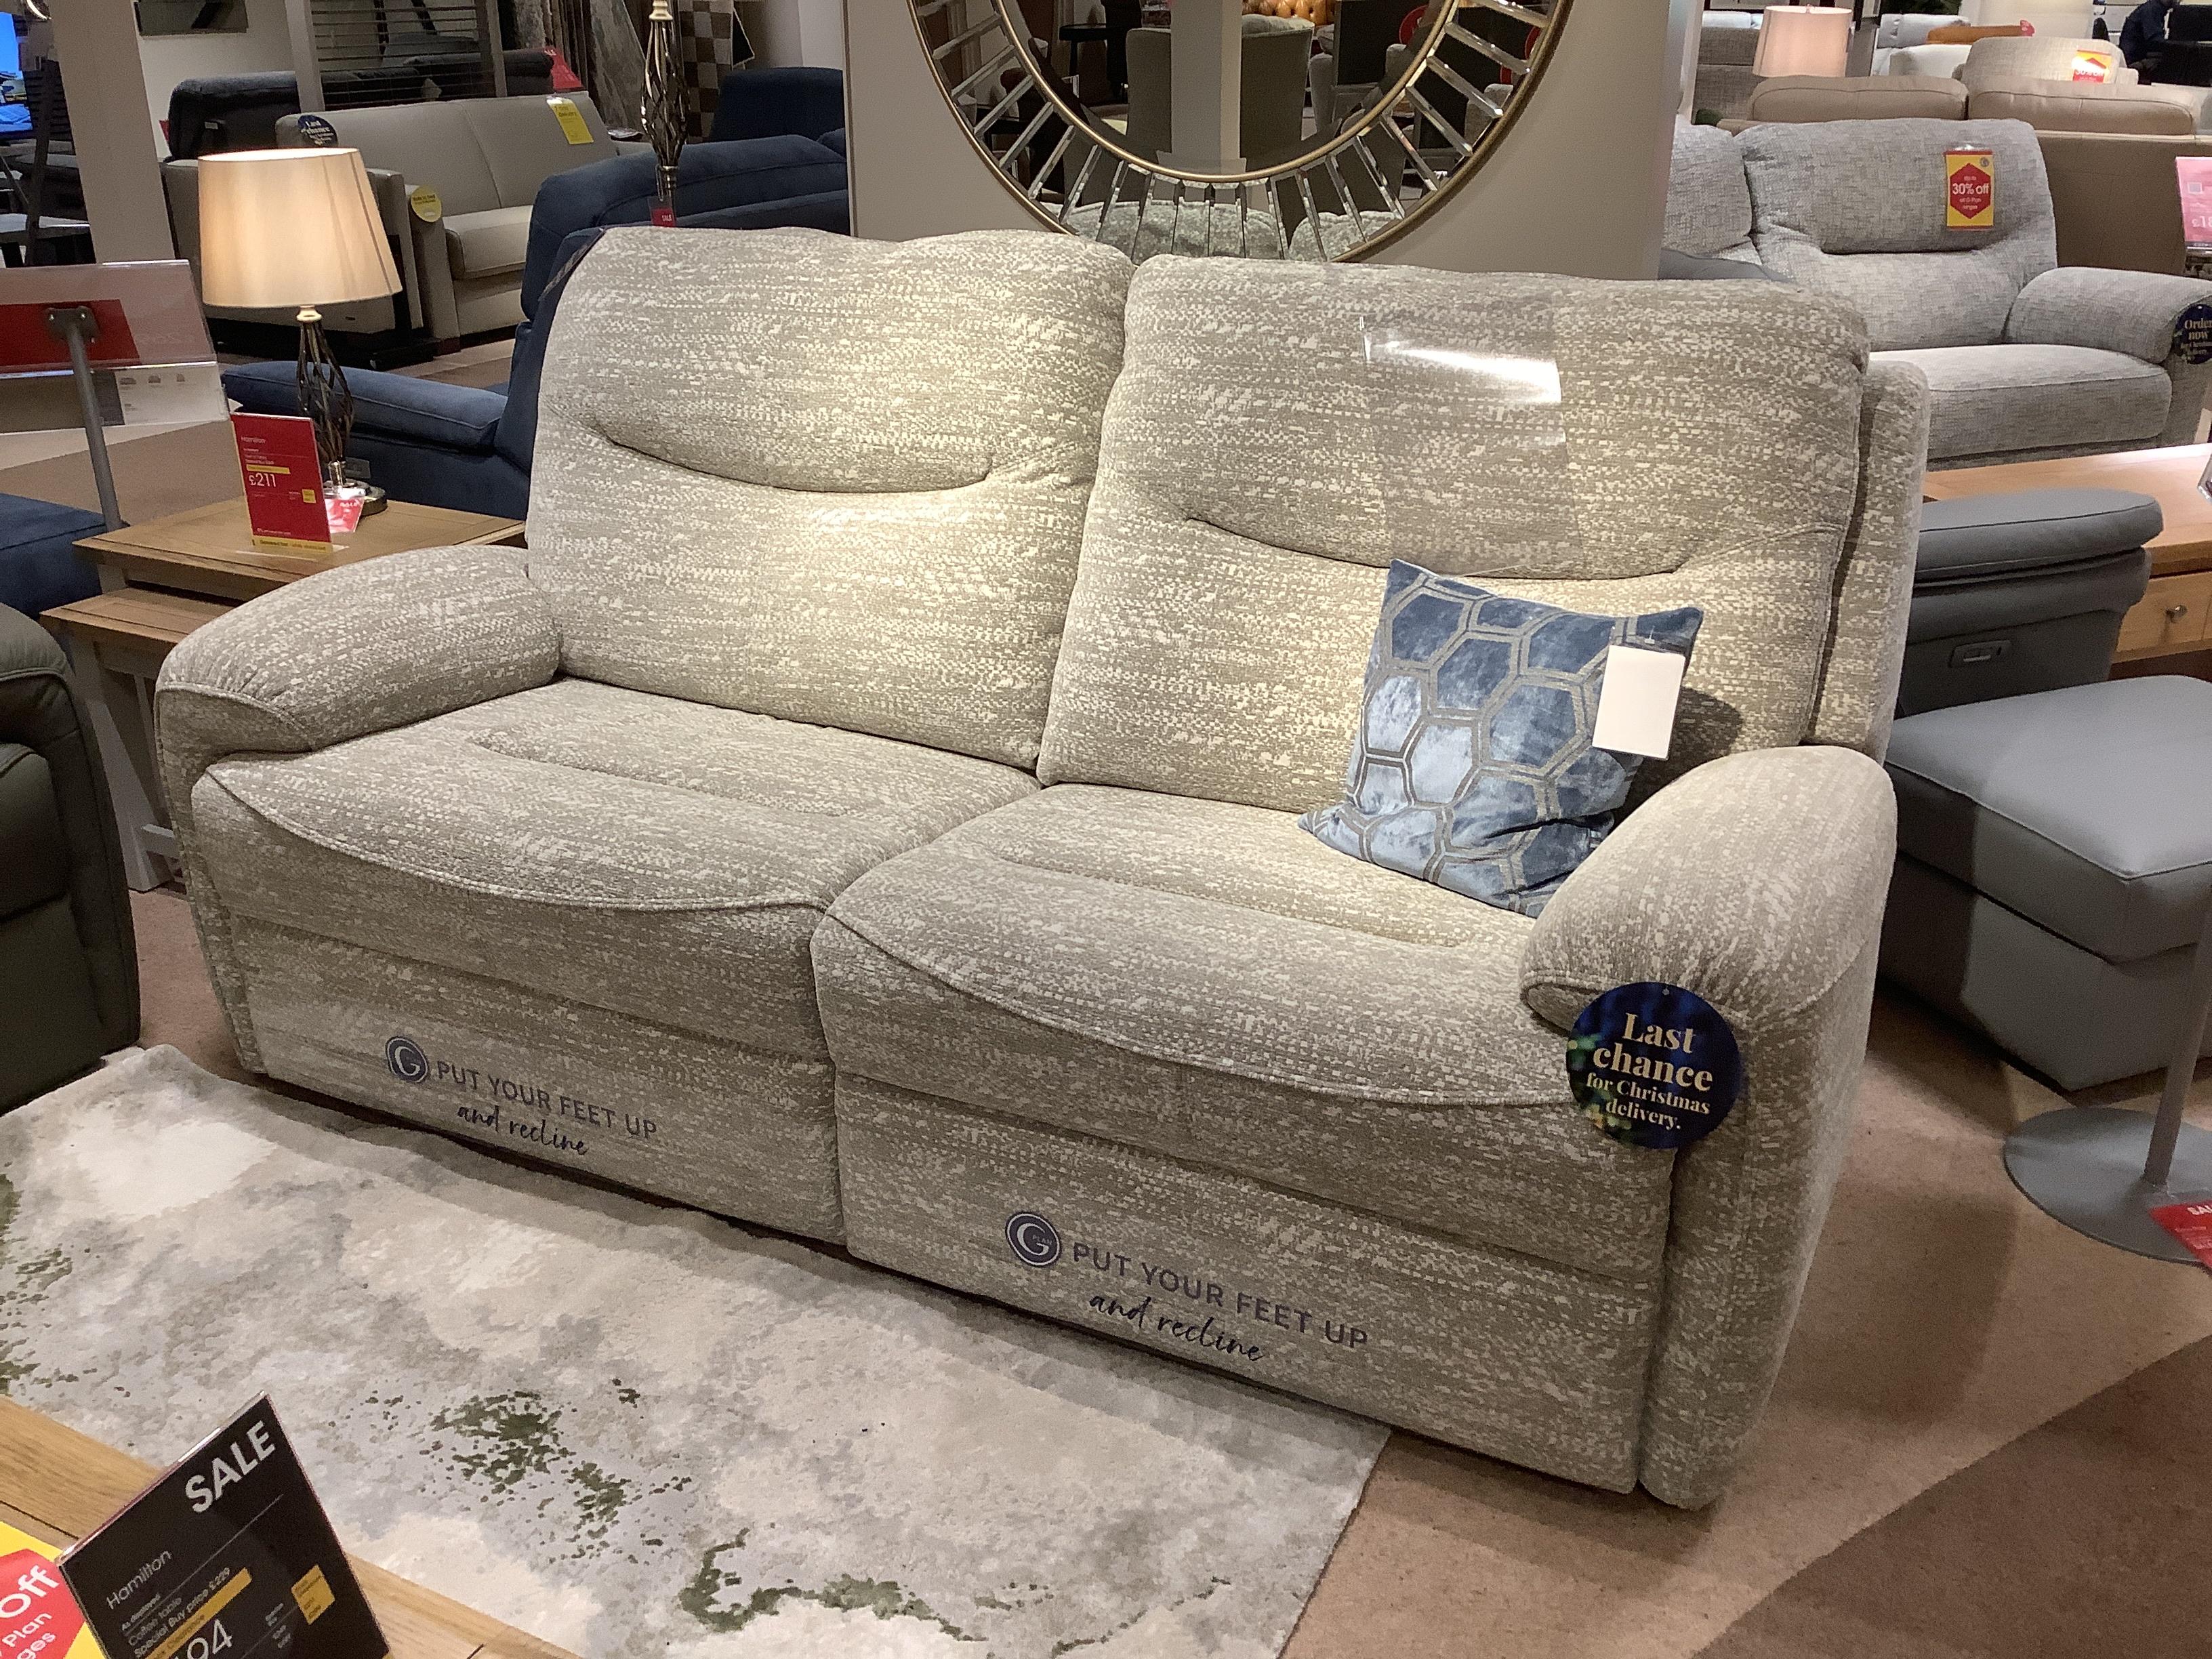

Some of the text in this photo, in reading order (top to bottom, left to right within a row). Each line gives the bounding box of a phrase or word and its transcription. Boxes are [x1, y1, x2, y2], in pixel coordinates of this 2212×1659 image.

[1952, 182, 1990, 195] 30% off
[249, 472, 276, 487] £211
[1622, 1012, 1696, 1054] Last
[1593, 1043, 1713, 1092] chance
[436, 1061, 658, 1139] PUT YOUR FEET UP
[1586, 1072, 1711, 1115] for Christmas
[1605, 1098, 1681, 1130] delivery.
[457, 1105, 590, 1155] and recline
[2186, 1205, 2212, 1215] SAL
[1073, 1242, 1369, 1349] PUT YOUR FEET UP
[1090, 1296, 1267, 1361] and recline
[185, 1420, 276, 1513] SALE
[106, 1551, 171, 1610] Hamilton
[1, 1612, 53, 1647] Plan
[168, 1610, 186, 1628] Buy
[16, 1633, 57, 1659] ges
